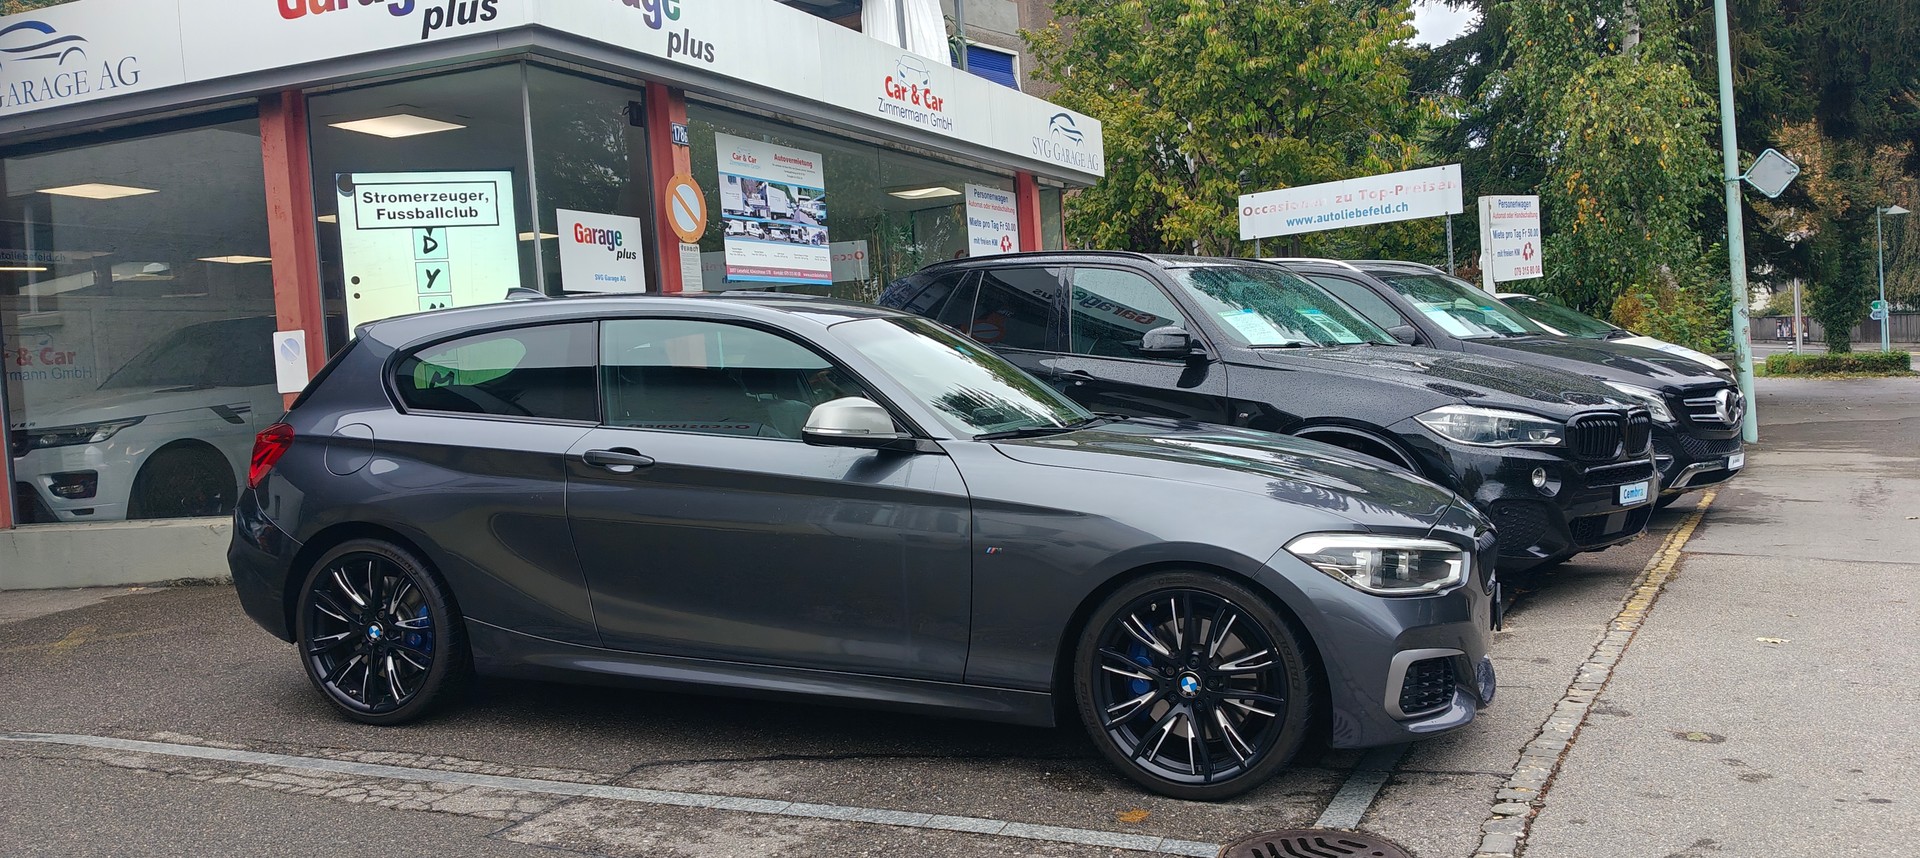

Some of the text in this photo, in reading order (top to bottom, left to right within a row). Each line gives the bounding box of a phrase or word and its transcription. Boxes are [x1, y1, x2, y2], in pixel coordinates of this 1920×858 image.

[421, 0, 498, 40] plus
[666, 28, 715, 63] plus
[0, 56, 141, 108] ARAGE AG
[885, 76, 943, 112] Car & Car
[878, 97, 953, 131] Zimmermann GmbH
[774, 154, 812, 169] Autovermietung
[1032, 136, 1099, 171] SVG GARAGE AG
[362, 191, 489, 204] Stromerzeuger,
[974, 188, 1008, 204] Personenwagen
[1336, 193, 1353, 204] zu
[1498, 199, 1531, 210] Personenwagen
[376, 206, 478, 220] Fussballclub
[1286, 202, 1409, 227] www.autoliebefeld.ch
[969, 217, 981, 227] Miete
[991, 220, 999, 231] Tag
[574, 222, 623, 251] Garage
[1493, 230, 1504, 239] Miete
[1522, 229, 1527, 237] Fr
[423, 235, 438, 254] D
[616, 248, 637, 261] plus
[425, 268, 441, 289] Y
[604, 274, 620, 282] Garage
[40, 347, 76, 366] Car
[51, 366, 92, 379] GmbH
[1624, 486, 1643, 499] Cembra
